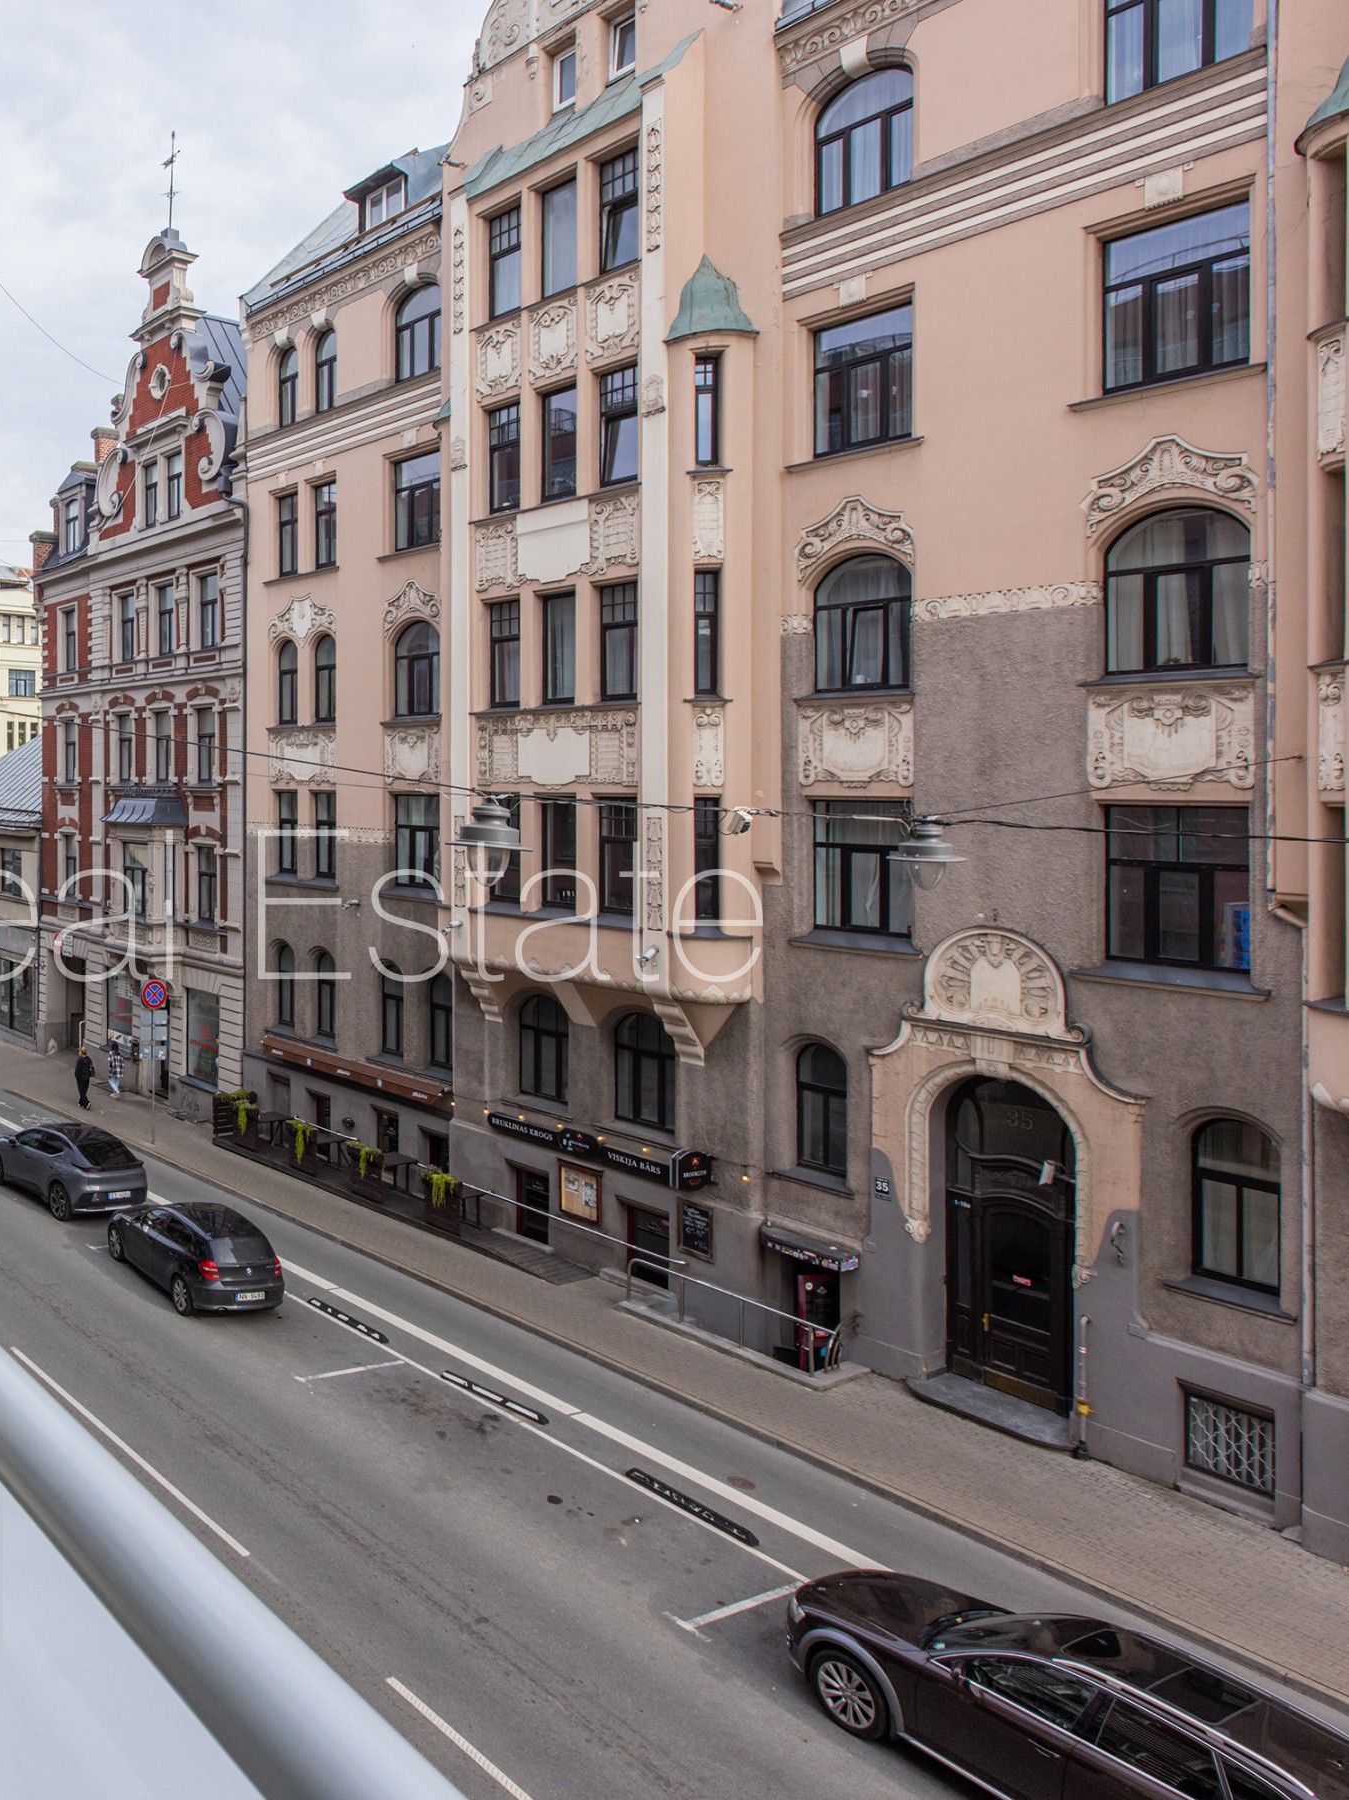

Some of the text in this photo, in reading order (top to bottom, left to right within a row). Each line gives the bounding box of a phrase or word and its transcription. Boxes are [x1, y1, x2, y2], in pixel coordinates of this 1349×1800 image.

[1006, 1109, 1034, 1130] 35
[491, 1117, 553, 1141] BRUKLINAS KROGS
[607, 1151, 637, 1168] VISKIJA
[683, 1170, 707, 1179] BROOKLYN
[875, 1181, 889, 1192] 35
